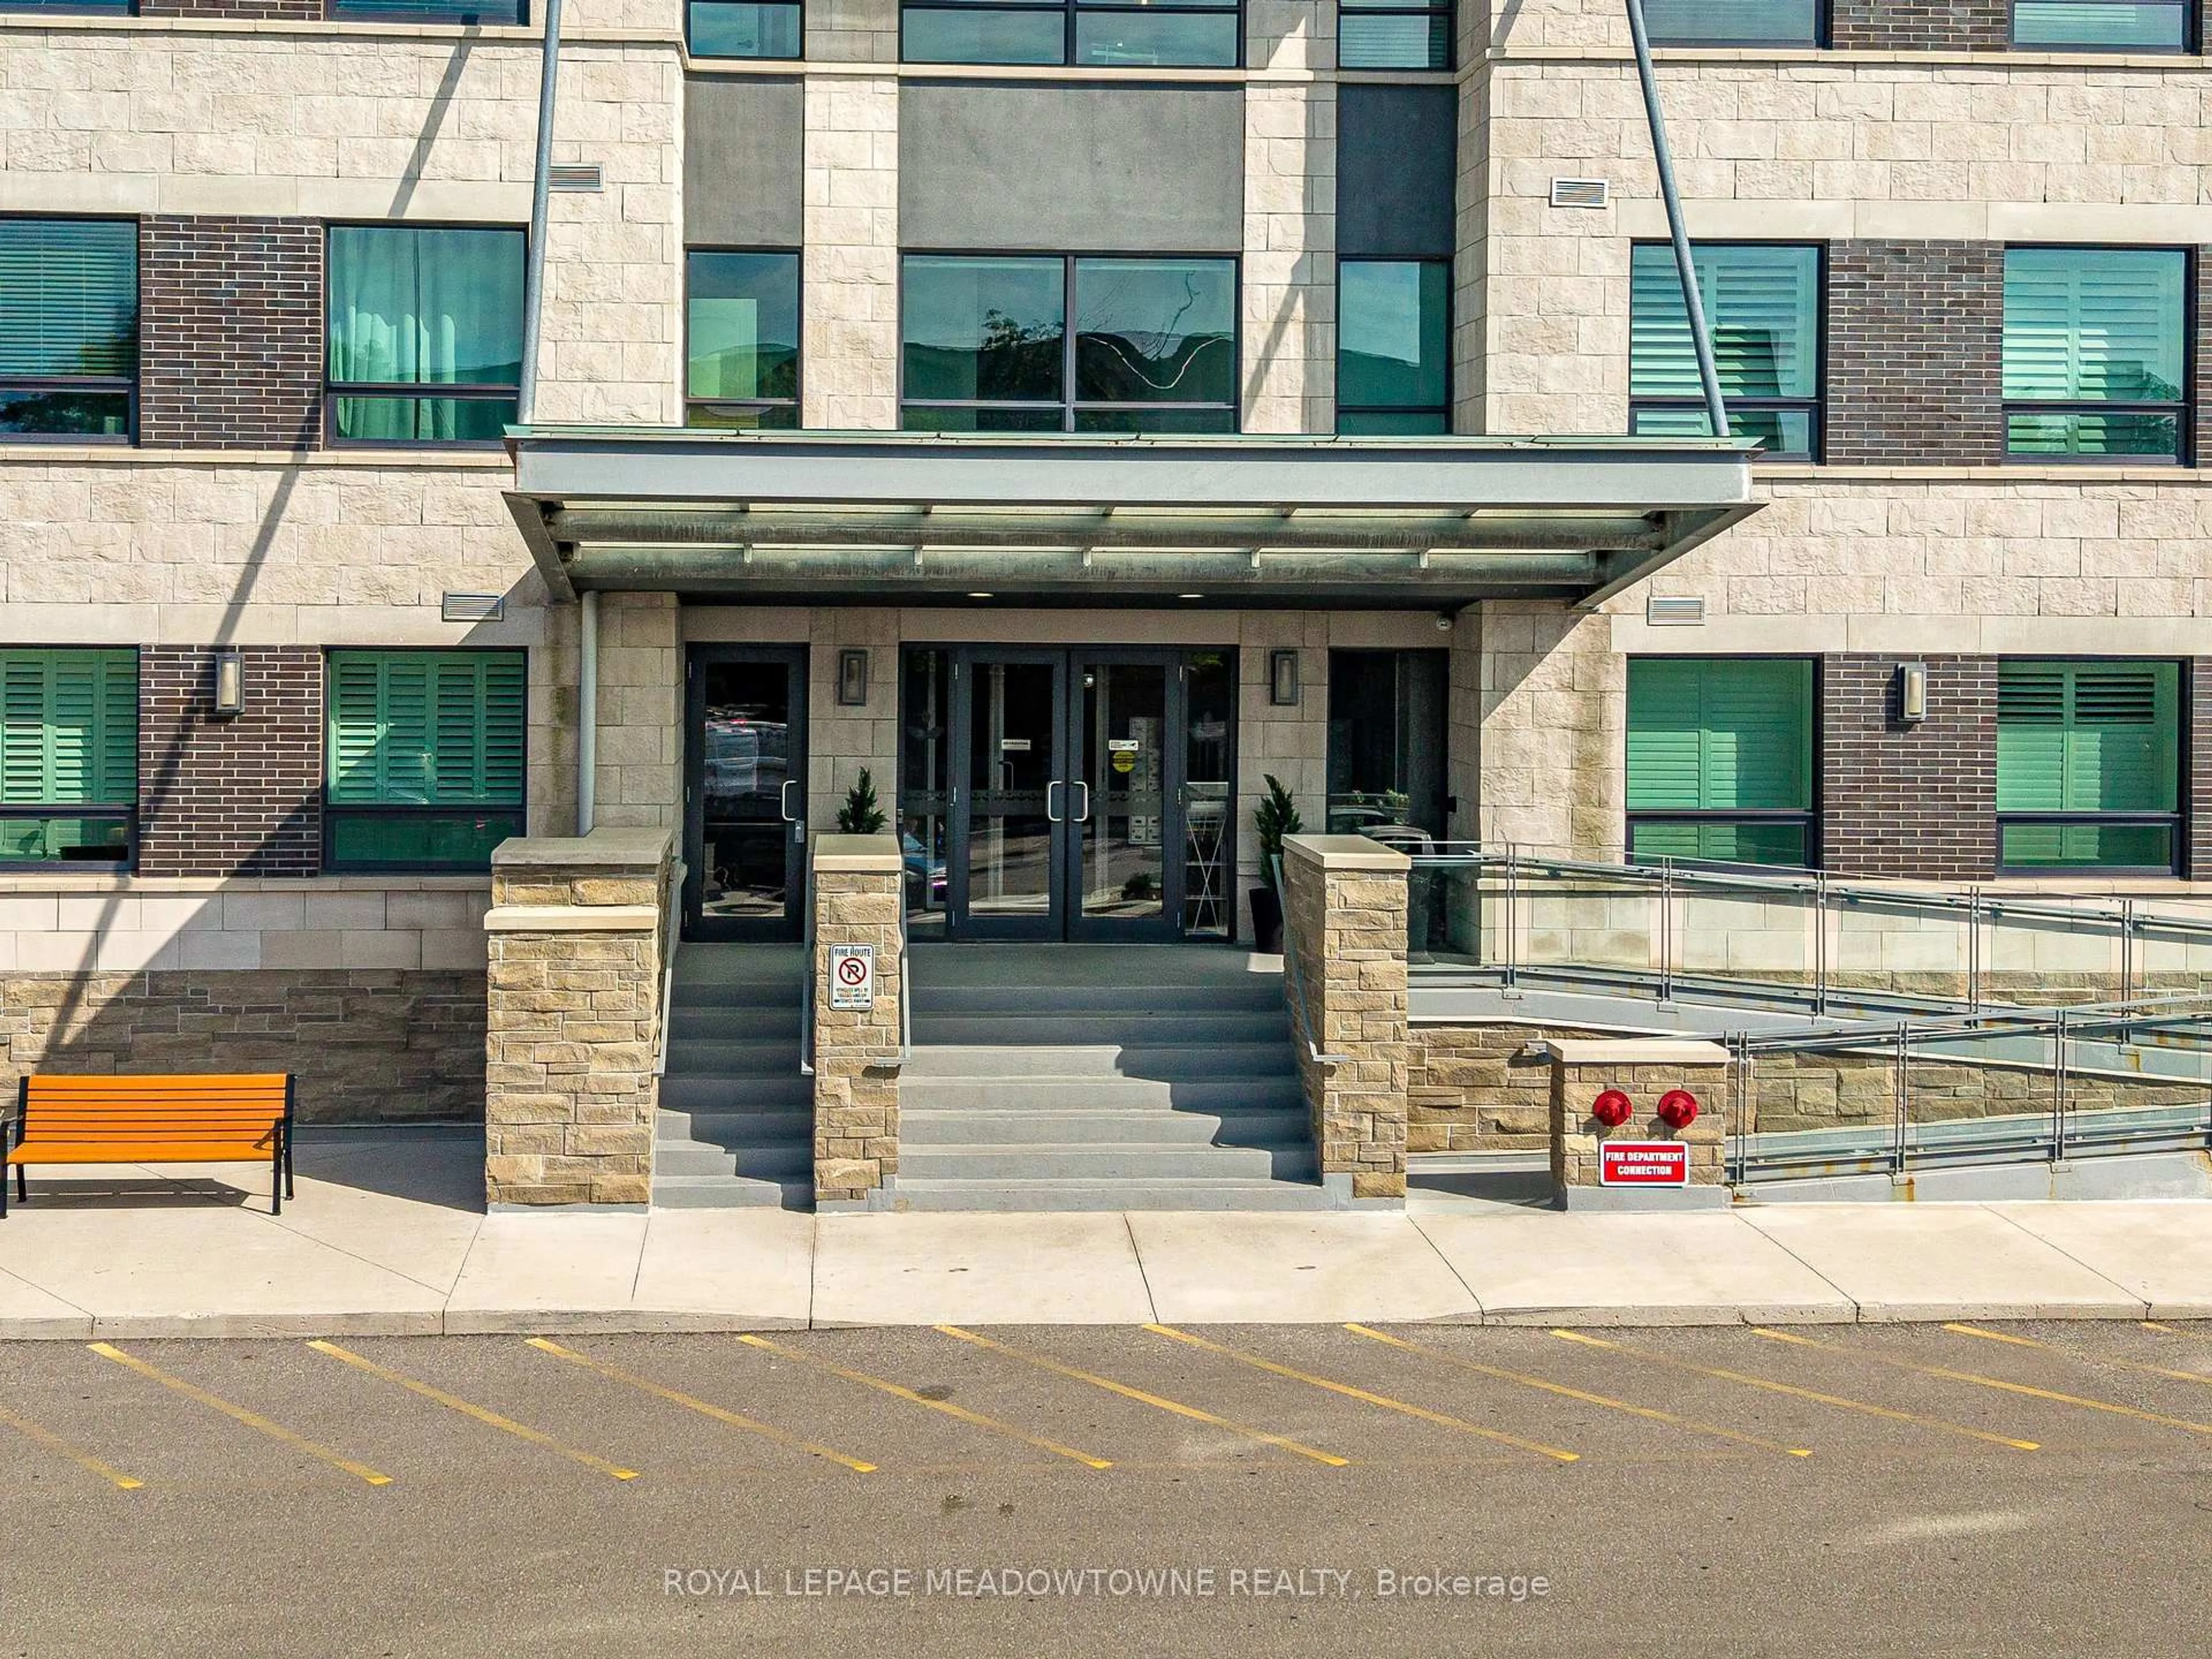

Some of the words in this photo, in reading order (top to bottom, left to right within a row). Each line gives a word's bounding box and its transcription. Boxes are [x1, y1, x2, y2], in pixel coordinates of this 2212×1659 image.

[835, 948, 848, 957] FIRE
[850, 948, 871, 957] ROUTE
[1606, 1152, 1625, 1161] FIRE
[1627, 1152, 1683, 1161] DEPARTMENT
[1618, 1166, 1672, 1175] CONNECTION
